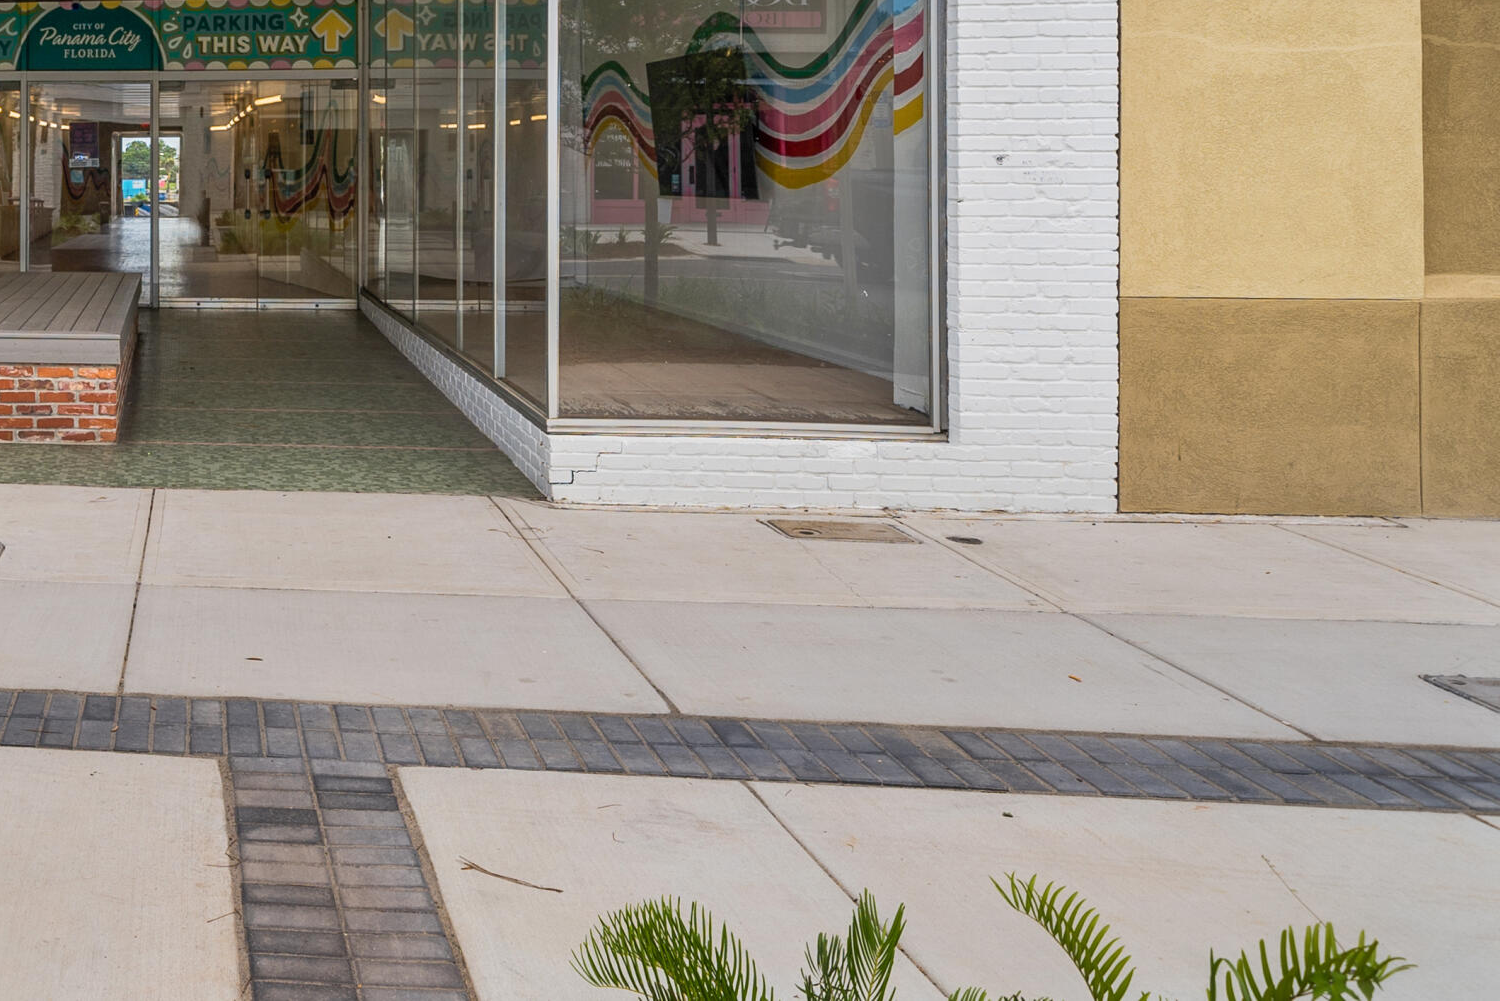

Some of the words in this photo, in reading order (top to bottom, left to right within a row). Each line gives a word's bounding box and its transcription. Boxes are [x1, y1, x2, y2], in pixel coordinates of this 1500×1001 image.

[72, 23, 93, 31] CITY
[182, 13, 286, 32] PARKING
[40, 26, 107, 46] Panama
[108, 26, 143, 52] City
[197, 35, 251, 54] THIS
[257, 34, 309, 53] WAY
[63, 48, 117, 59] FLORIDA
